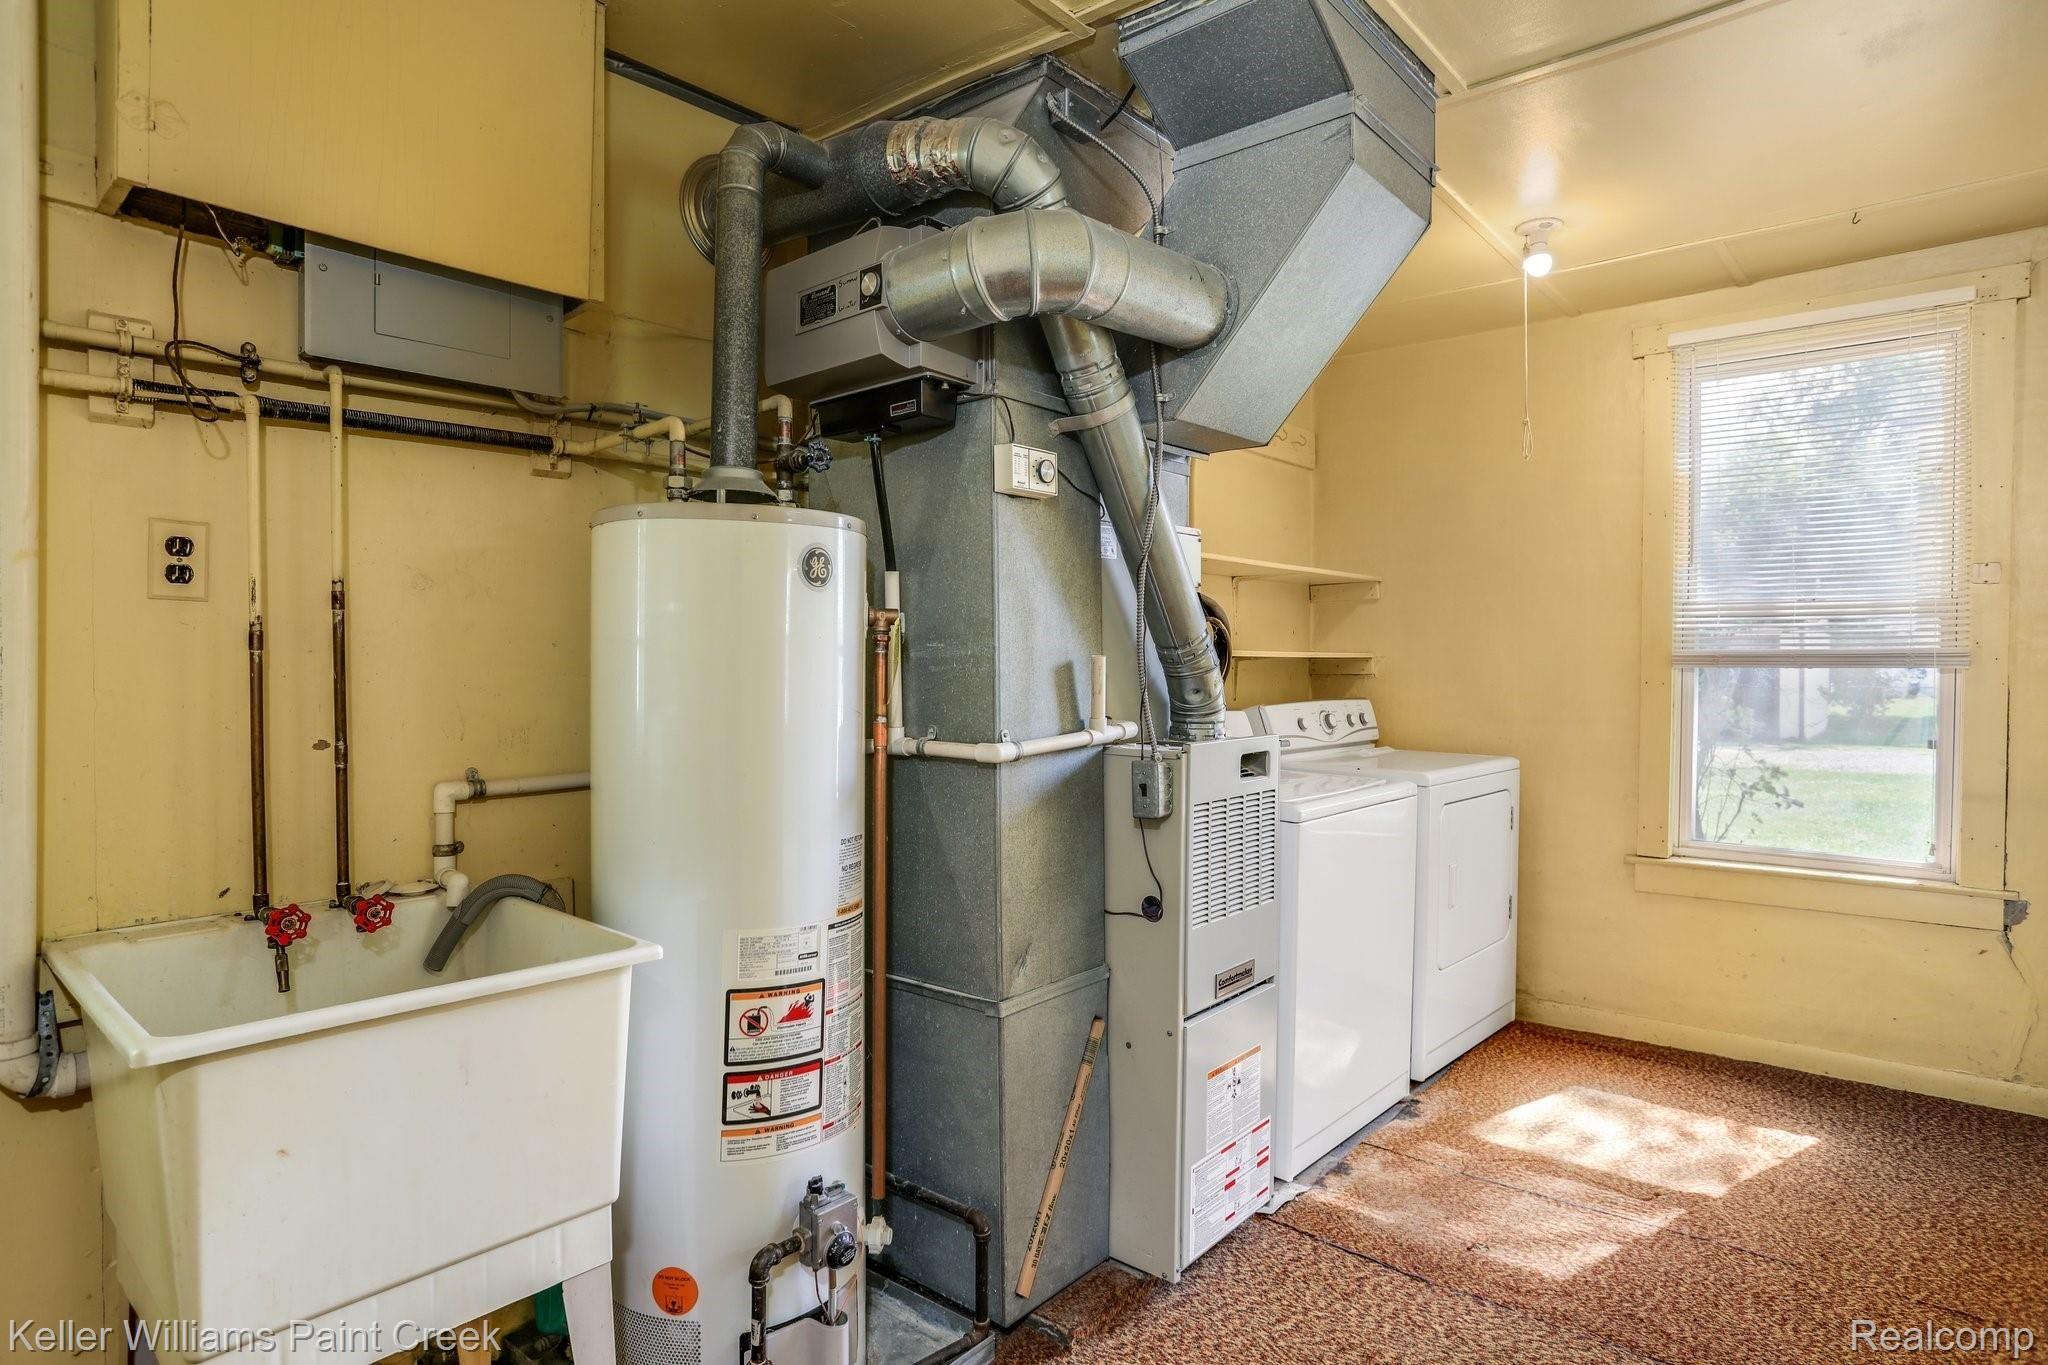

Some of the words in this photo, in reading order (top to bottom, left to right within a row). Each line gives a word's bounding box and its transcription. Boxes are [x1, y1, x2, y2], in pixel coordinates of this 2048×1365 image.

[810, 557, 826, 578] GE
[768, 989, 801, 997] WARNING
[765, 1071, 793, 1079] DANGER
[764, 1123, 794, 1132] WARNING
[1060, 1130, 1075, 1168] 20x20x1
